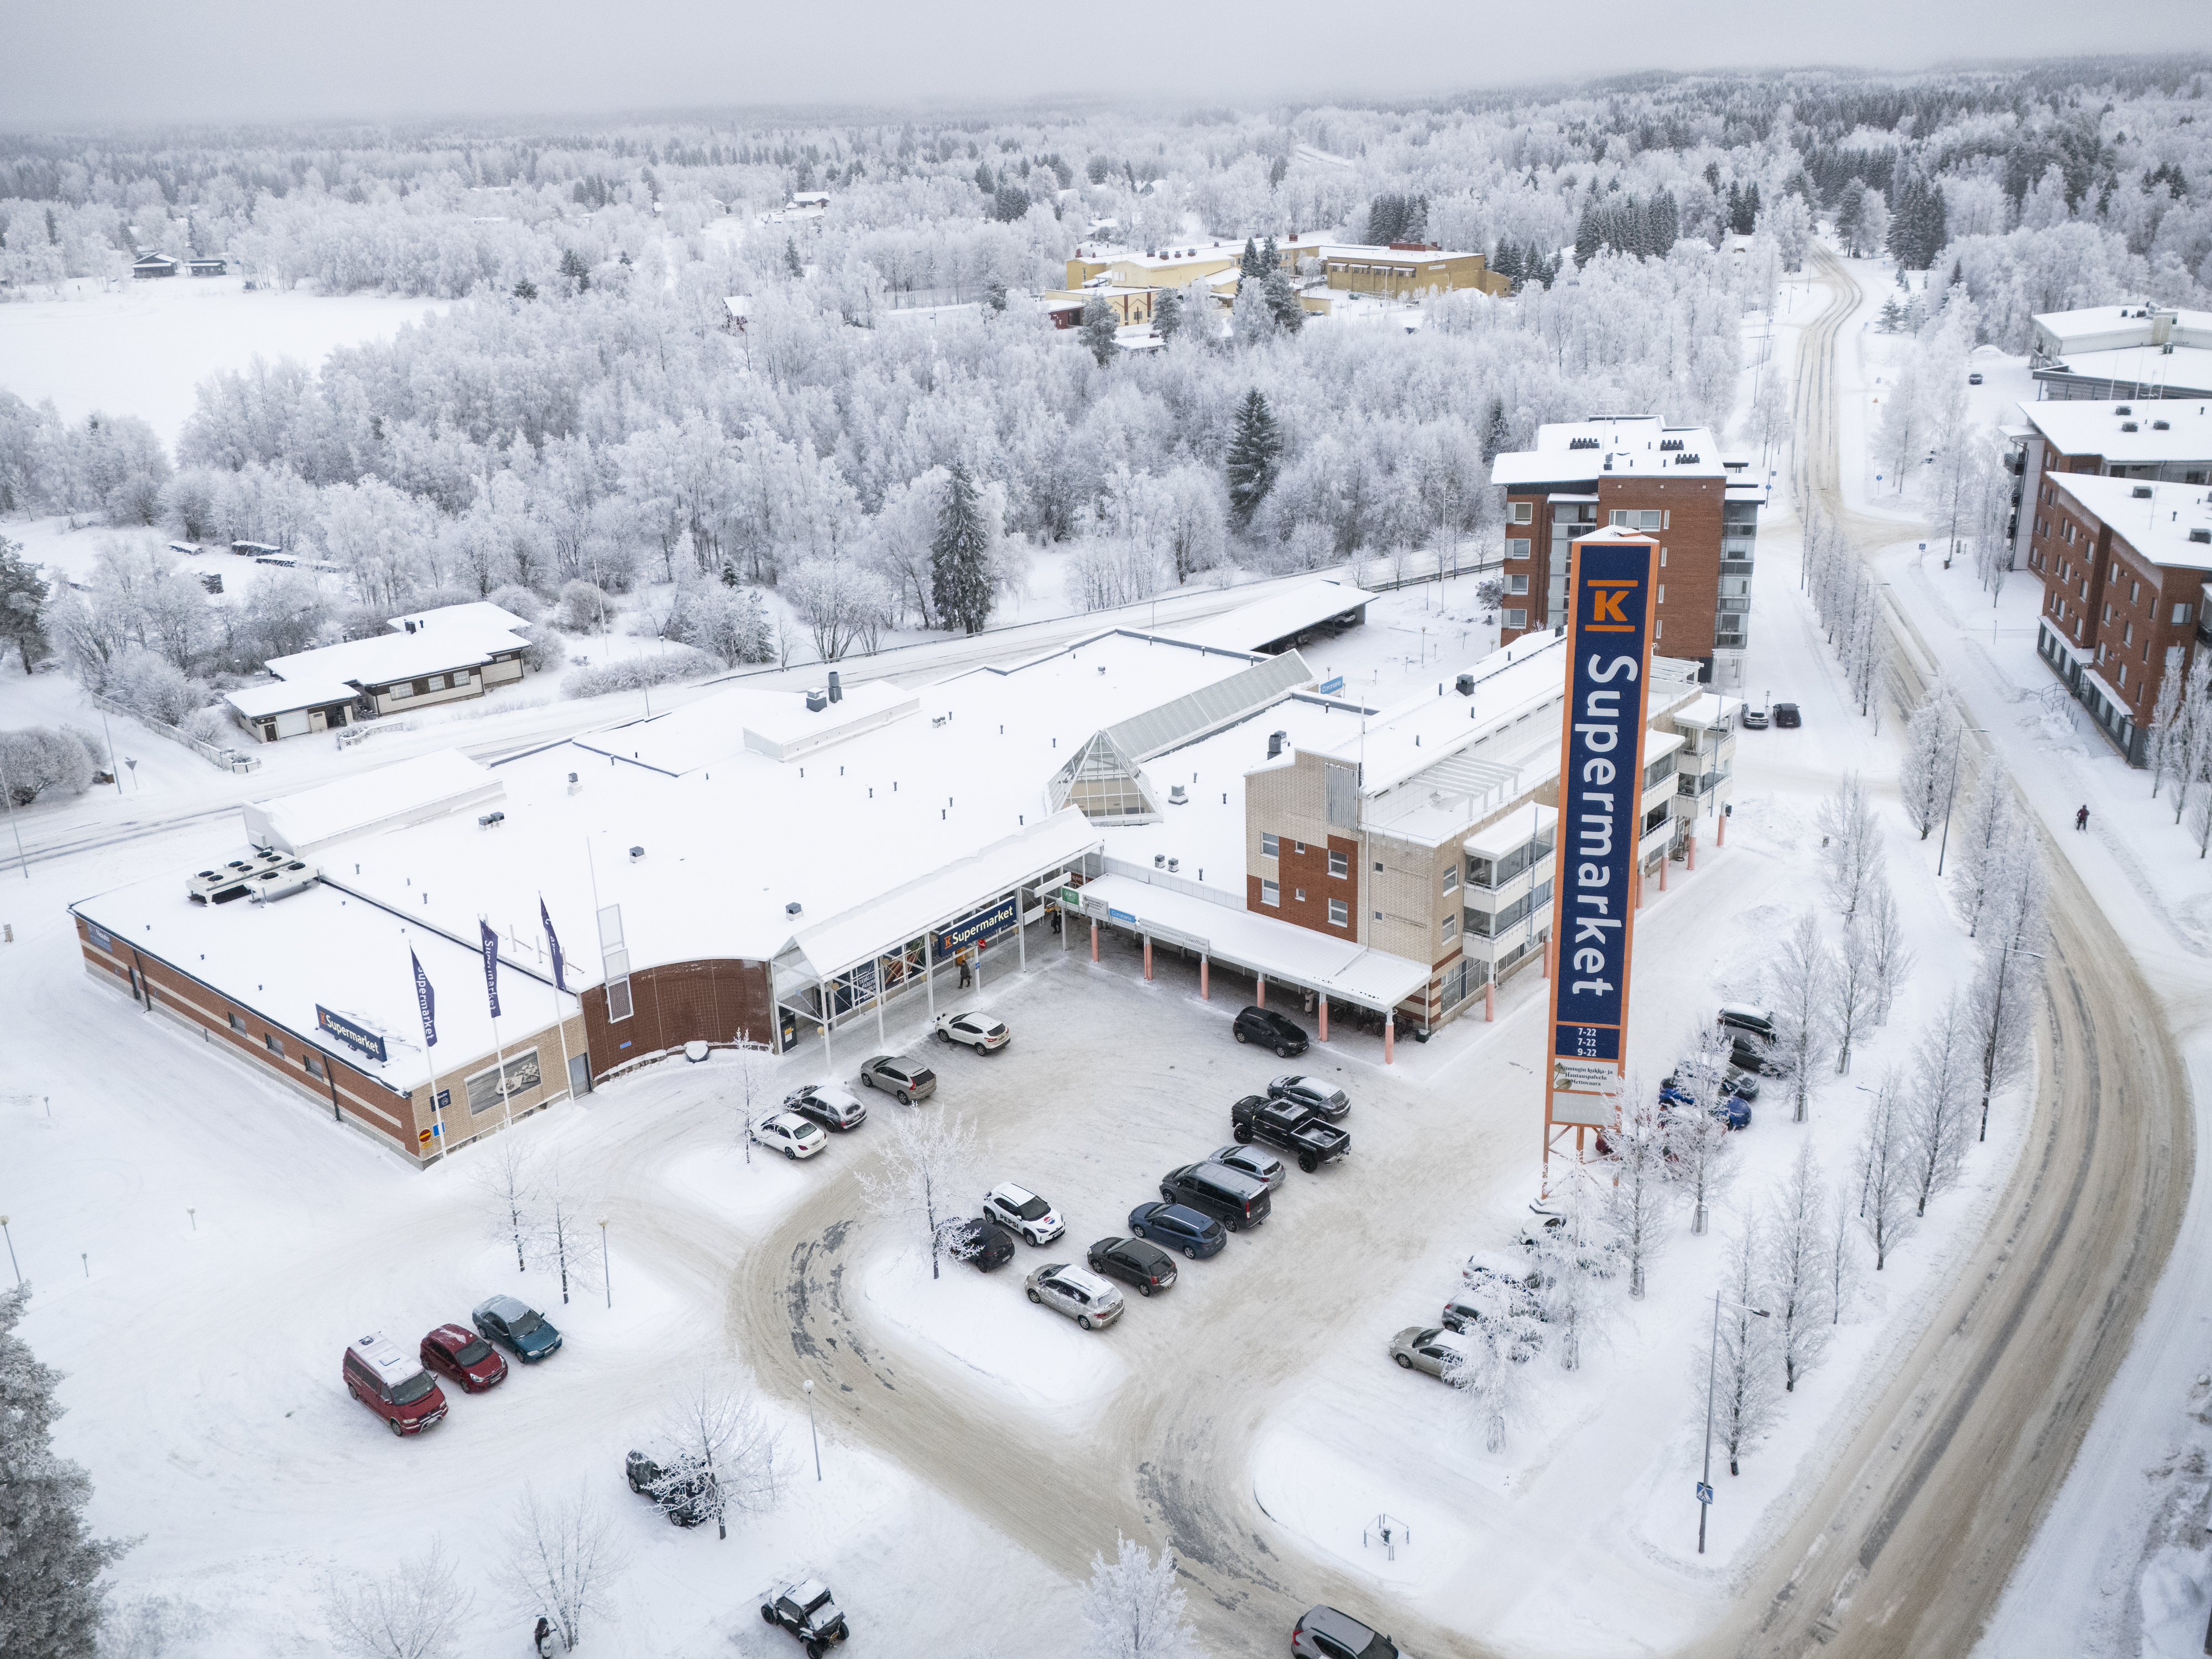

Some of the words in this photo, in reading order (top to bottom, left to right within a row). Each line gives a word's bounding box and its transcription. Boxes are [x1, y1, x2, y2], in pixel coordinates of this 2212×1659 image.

[1593, 590, 1629, 622] K
[1322, 680, 1341, 692] Coronaria
[1572, 654, 1638, 996] Supermarket
[1111, 910, 1133, 921] Coronaria
[952, 905, 1013, 945] Supermarket
[326, 1015, 379, 1054] Supermarket
[1578, 1027, 1597, 1036] 7-22
[1578, 1037, 1597, 1046] 7-22
[1578, 1047, 1597, 1057] 9-22
[1564, 1072, 1607, 1081] Hautauspalvelu
[999, 1213, 1019, 1229] PEPSI
